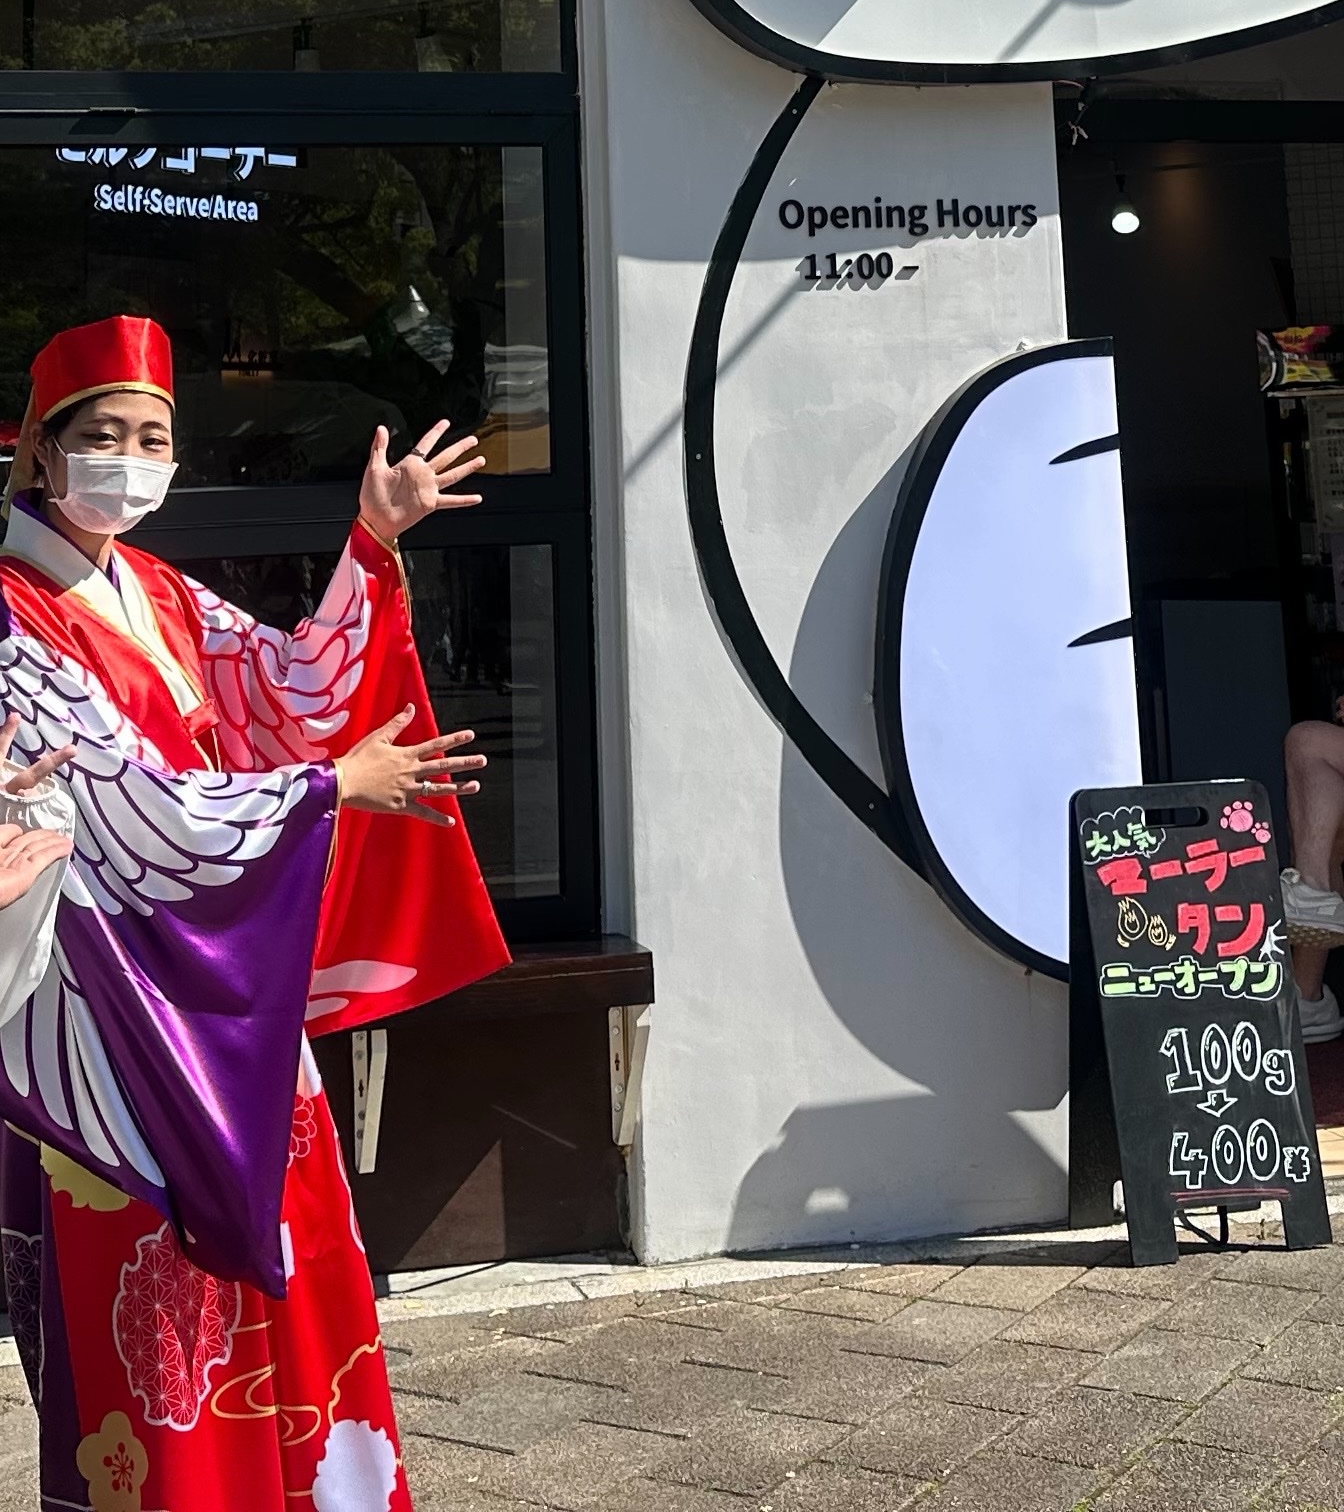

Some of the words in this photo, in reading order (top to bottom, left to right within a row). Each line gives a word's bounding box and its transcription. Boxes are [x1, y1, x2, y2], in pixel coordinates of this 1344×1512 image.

[97, 185, 212, 219] Self-Serve
[212, 194, 259, 221] Area
[778, 196, 928, 237] Opening
[936, 198, 1038, 228] Hours
[1085, 822, 1157, 857] 大人気
[1096, 838, 1267, 897] マーラー
[1177, 902, 1265, 957] タン
[1102, 958, 1281, 996] ニューオープン
[1159, 1021, 1297, 1096] 100g
